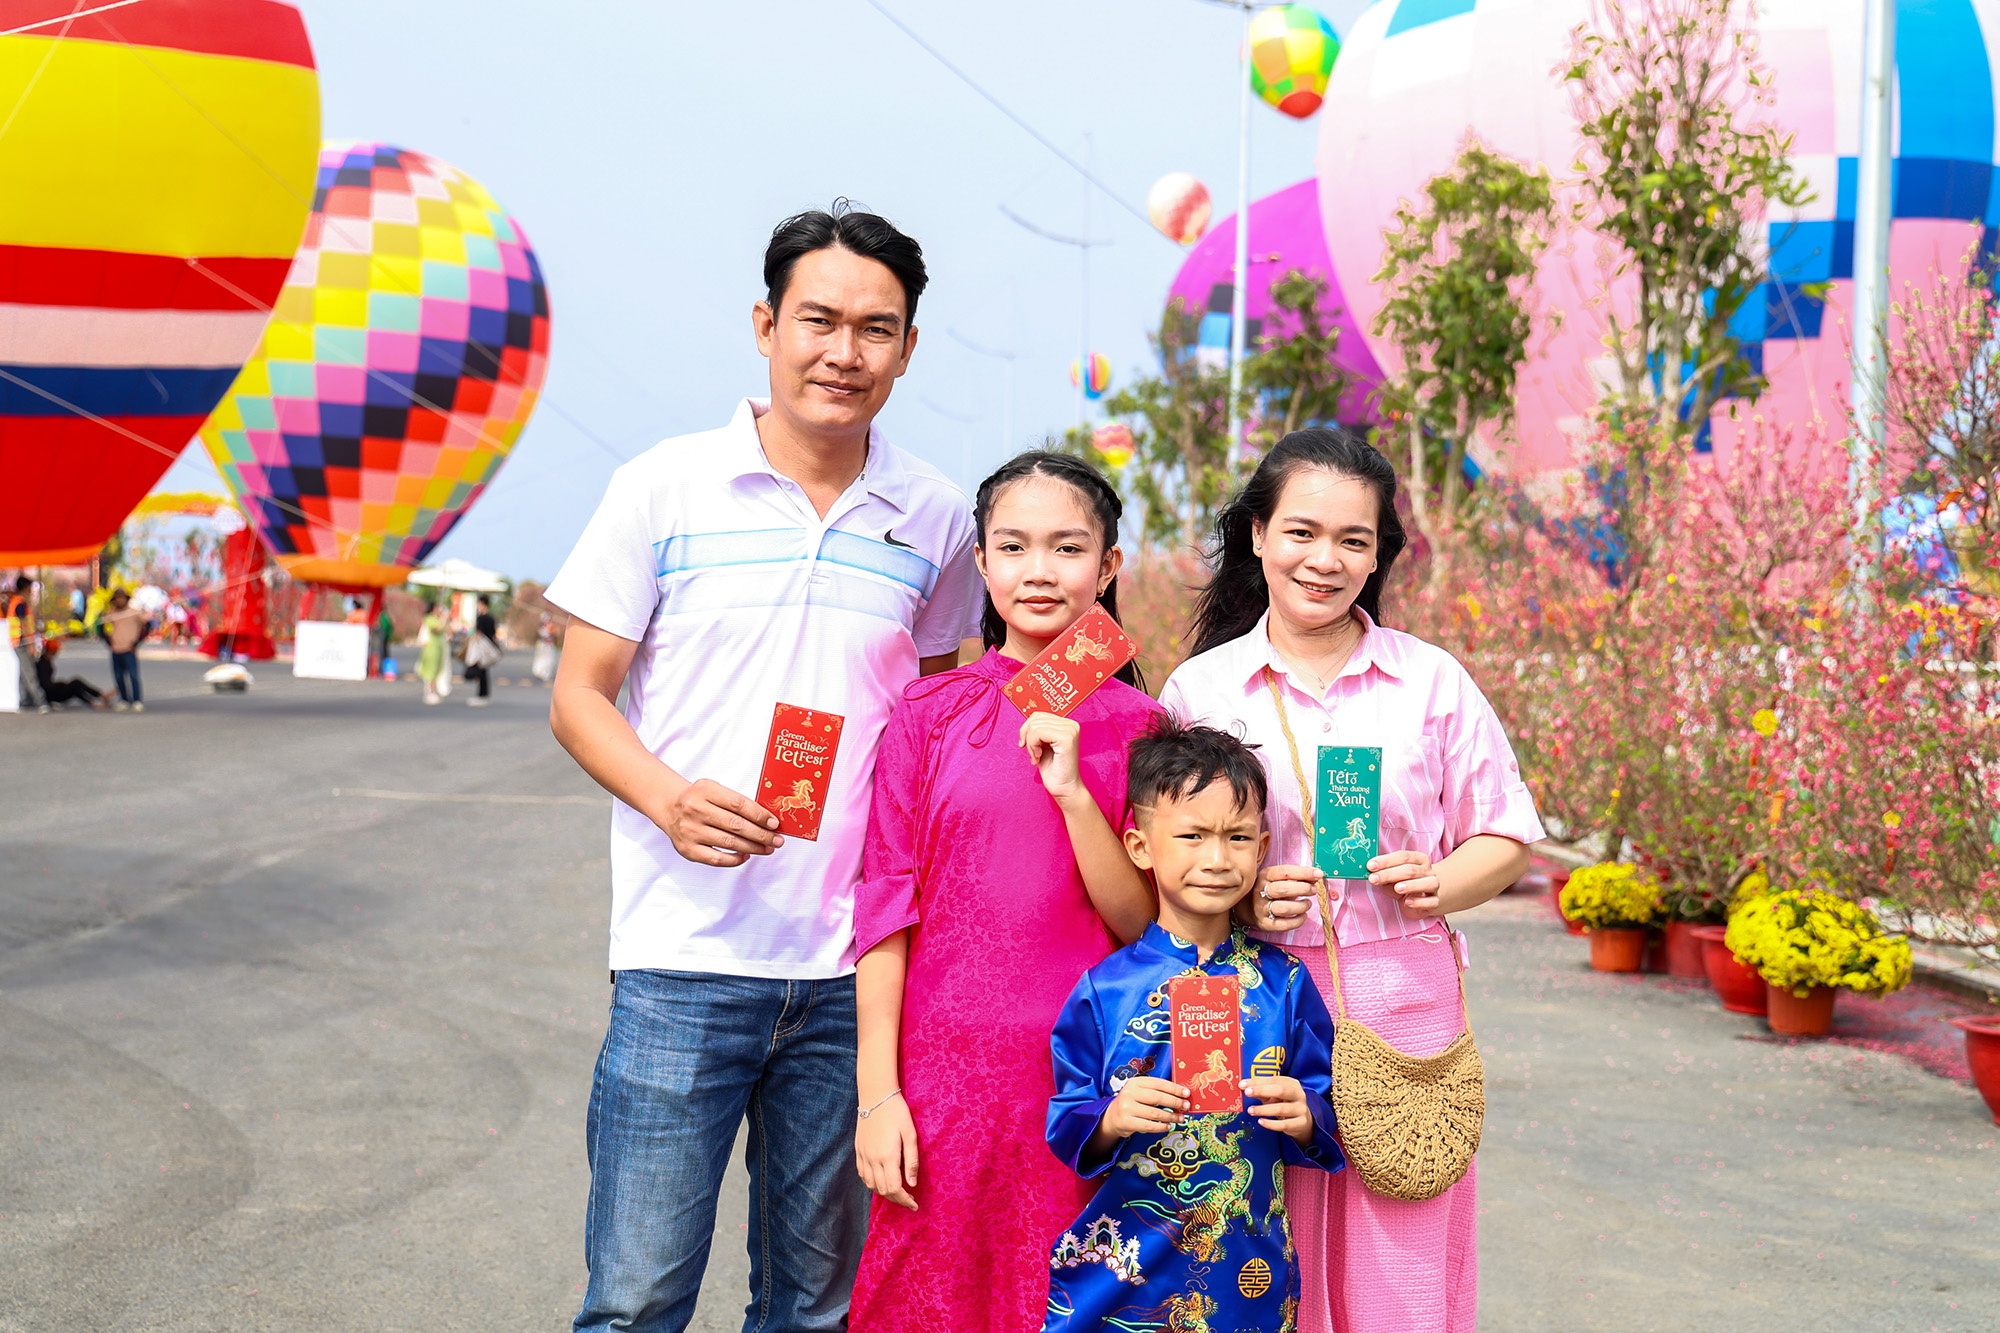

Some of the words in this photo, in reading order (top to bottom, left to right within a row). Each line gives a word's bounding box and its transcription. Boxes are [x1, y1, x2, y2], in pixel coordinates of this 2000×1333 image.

[1031, 672, 1069, 711] Paradise
[1042, 692, 1059, 712] Green
[775, 734, 828, 754] Paradise
[780, 728, 805, 741] Green
[1328, 789, 1371, 809] Xanh
[1178, 1009, 1230, 1021] Paradise
[1181, 1003, 1205, 1011] Green
